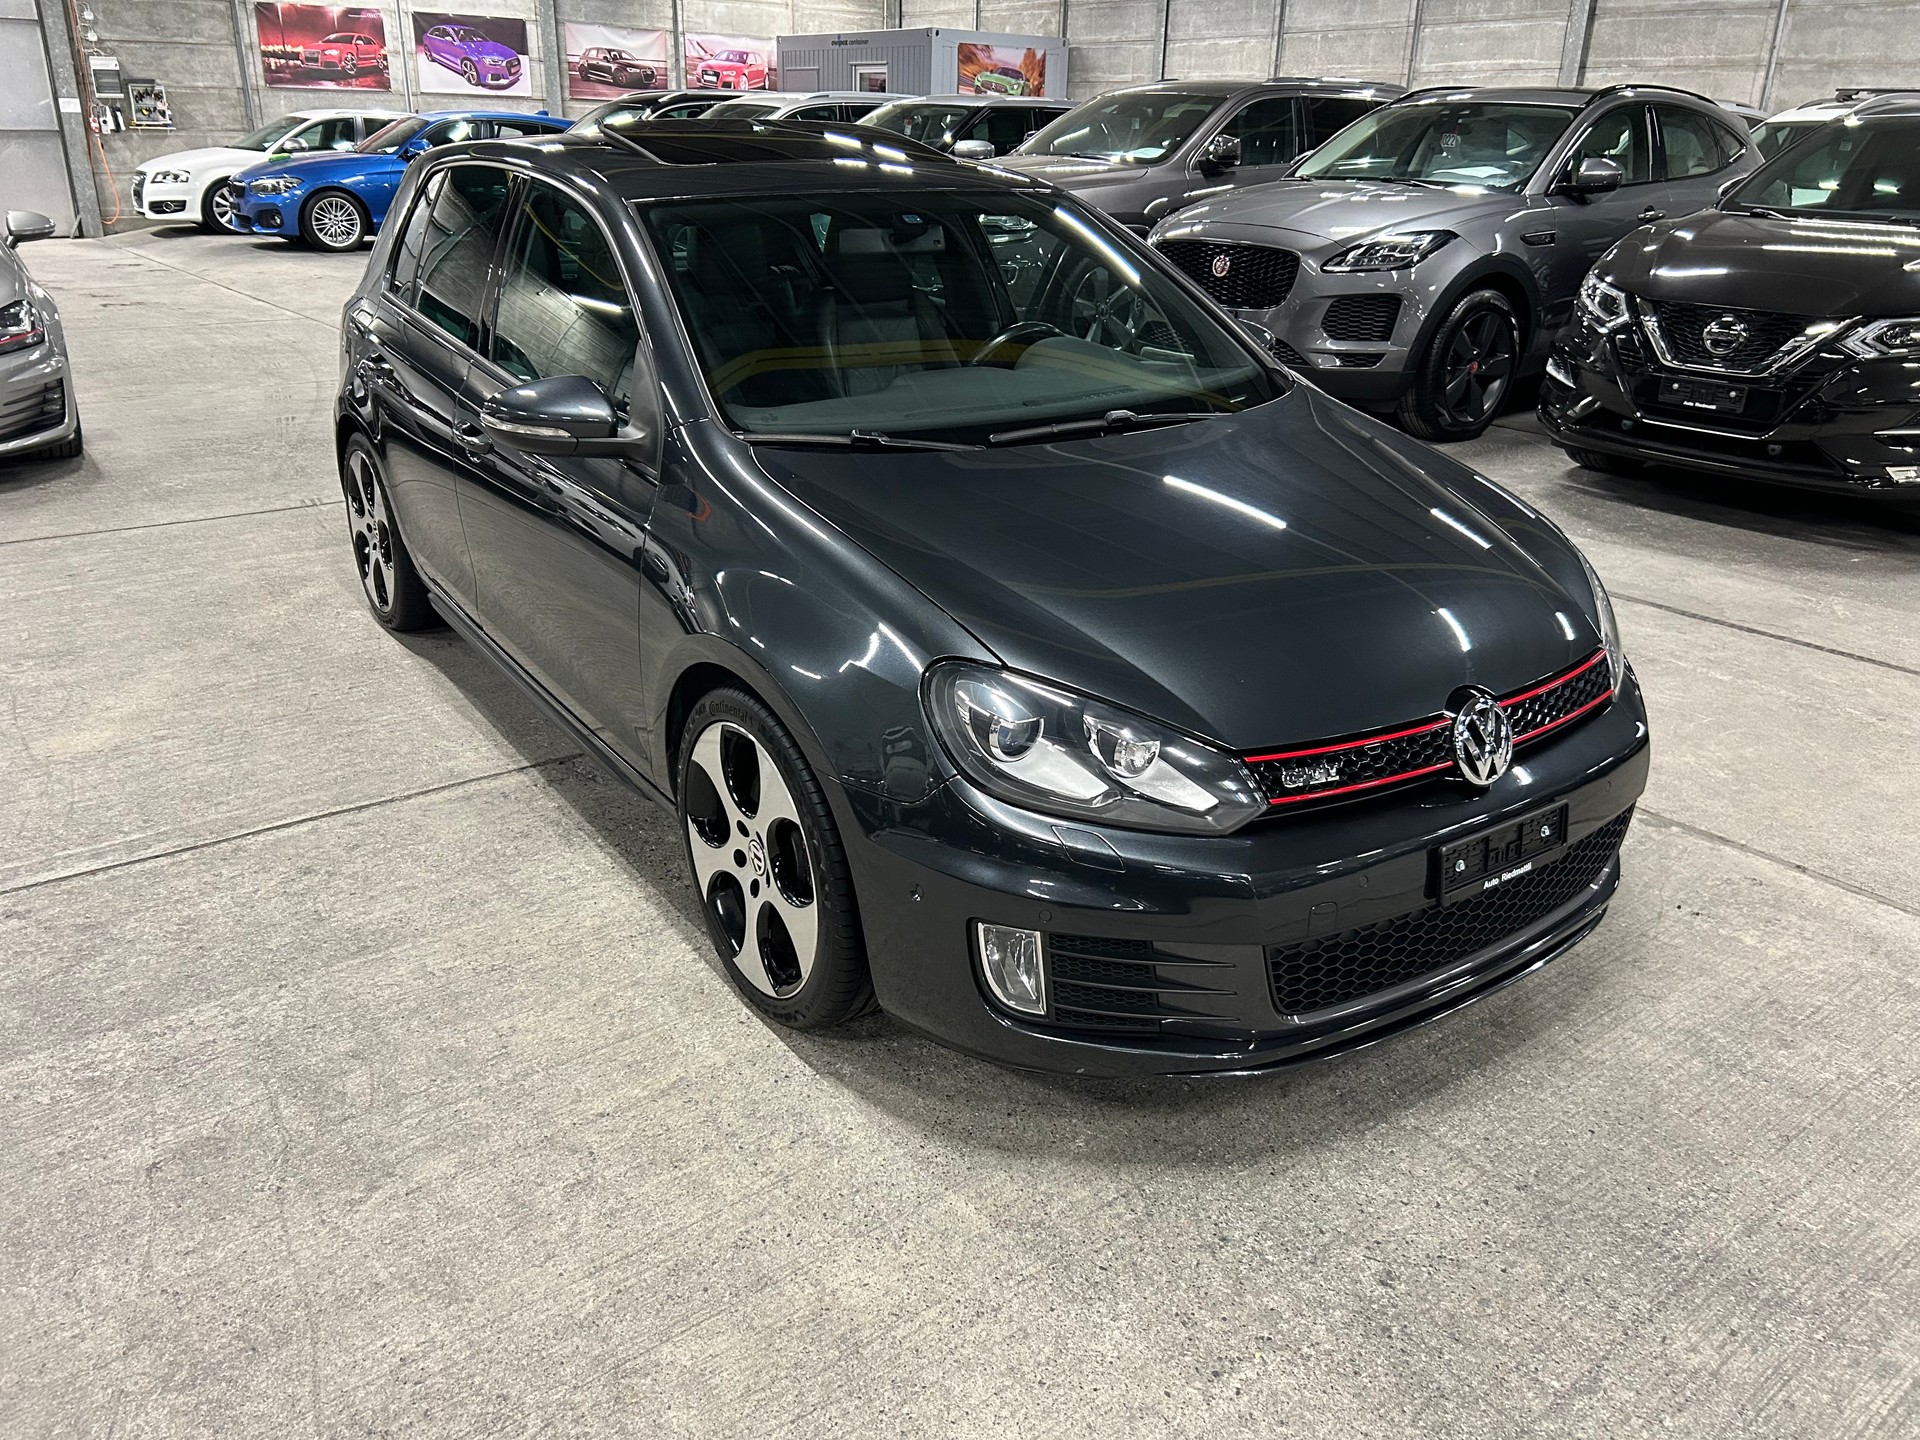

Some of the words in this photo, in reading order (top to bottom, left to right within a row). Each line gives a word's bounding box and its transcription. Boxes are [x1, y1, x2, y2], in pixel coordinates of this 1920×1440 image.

[849, 38, 870, 46] container
[708, 700, 748, 724] Continental
[1281, 763, 1340, 788] GTI
[1483, 878, 1500, 890] Auto
